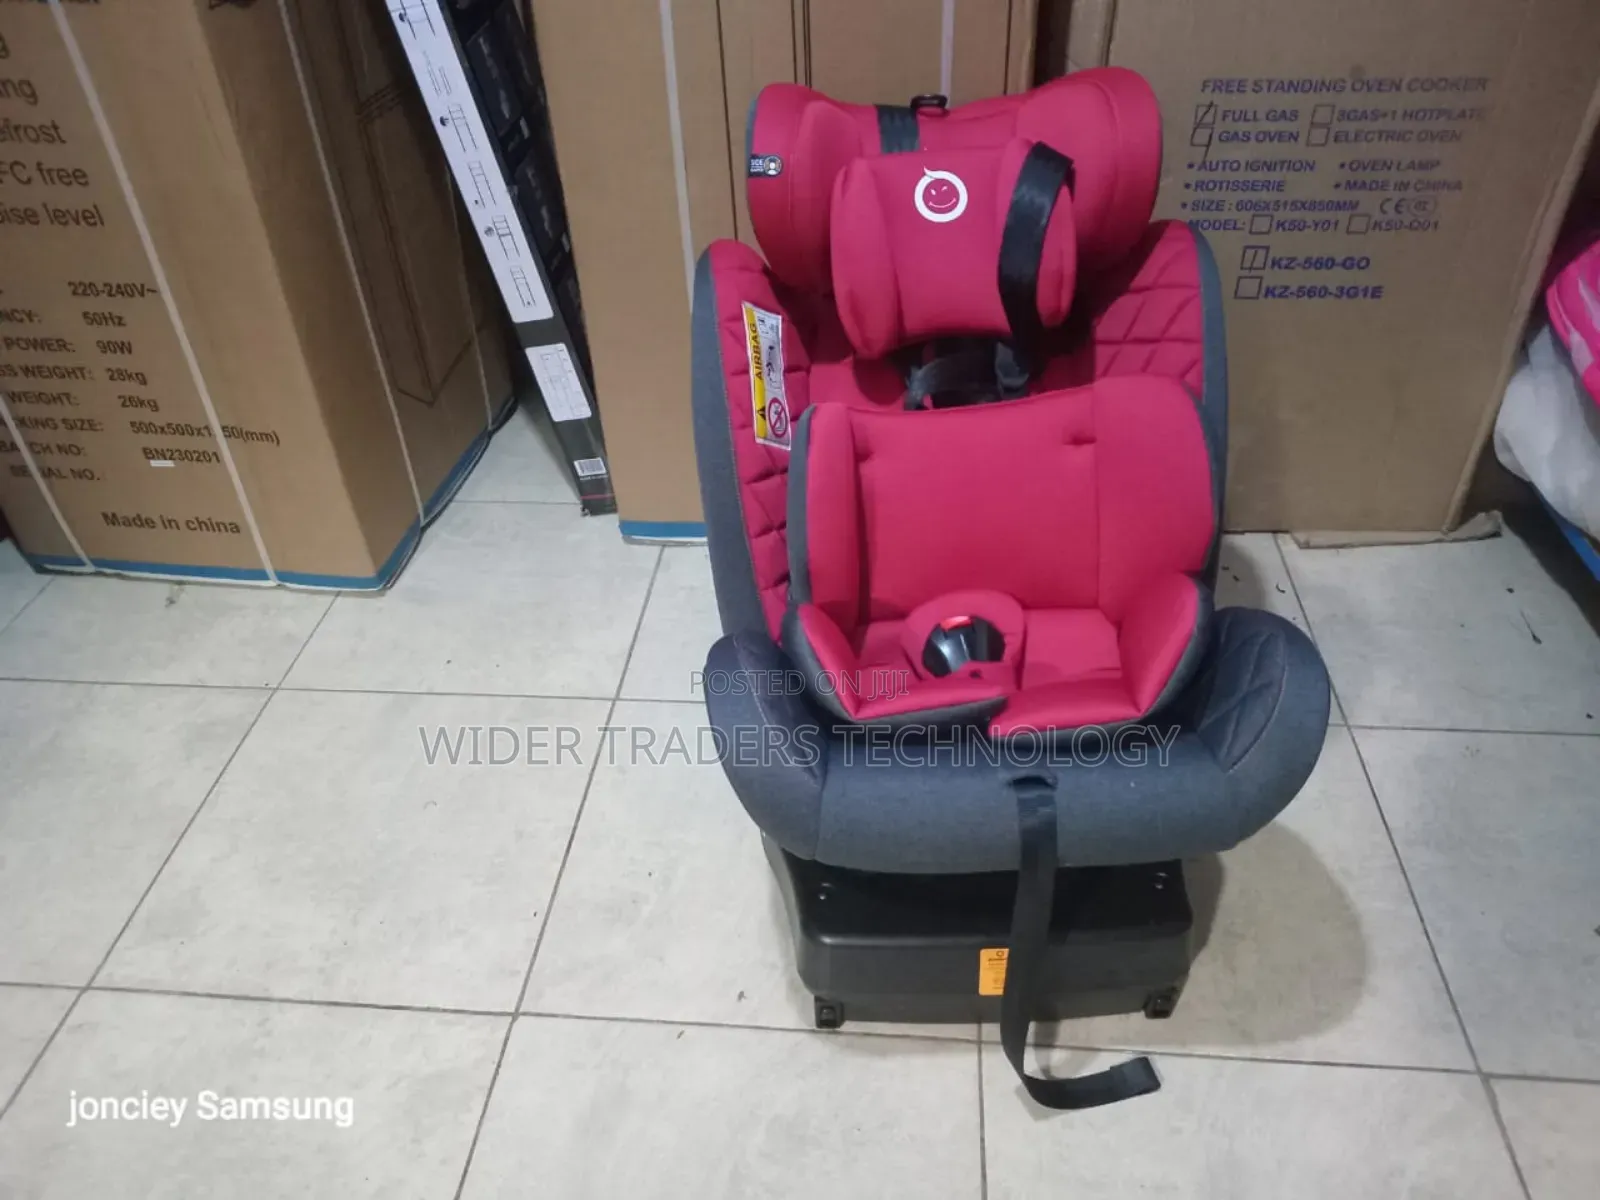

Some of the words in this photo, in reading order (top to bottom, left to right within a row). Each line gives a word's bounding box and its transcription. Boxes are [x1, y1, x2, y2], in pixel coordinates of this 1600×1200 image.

[0, 79, 38, 107] ng
[1200, 78, 1248, 93] FREE
[1251, 78, 1346, 93] STANDING
[1350, 78, 1403, 93] OVEN
[1406, 77, 1490, 93] COOKER
[1221, 109, 1259, 122] FULL
[1265, 109, 1300, 122] GAS
[1218, 130, 1250, 143] GAS
[1255, 130, 1300, 143] OVEN
[1333, 129, 1414, 143] ELECTRIC
[1416, 129, 1464, 143] OVEN
[35, 160, 89, 187] free
[1197, 159, 1241, 172] AUTO
[1244, 159, 1316, 172] IGNITION
[1348, 159, 1393, 172] OVEN
[1396, 159, 1441, 171] LAMP
[1193, 179, 1287, 192] ROTISSERIE
[1343, 179, 1390, 191] MADE
[1393, 180, 1411, 192] IN
[1413, 180, 1463, 192] CHINA
[41, 201, 105, 227] level
[1263, 285, 1385, 300] KZ-560-3G1E
[82, 311, 127, 327] 50Hz
[3, 337, 76, 353] POWER:
[95, 340, 133, 355] 90W
[749, 323, 764, 381] AIRBAG
[18, 364, 95, 380] WEIGHT:
[105, 367, 148, 386] 28kg
[117, 395, 160, 413] 26kg
[61, 418, 104, 432] SIZE:
[129, 421, 281, 447] 500x500x150(mm)
[142, 447, 221, 464] BN230201
[69, 467, 100, 481] NO.
[101, 511, 156, 530] Made
[159, 515, 181, 531] in
[185, 517, 241, 534] china
